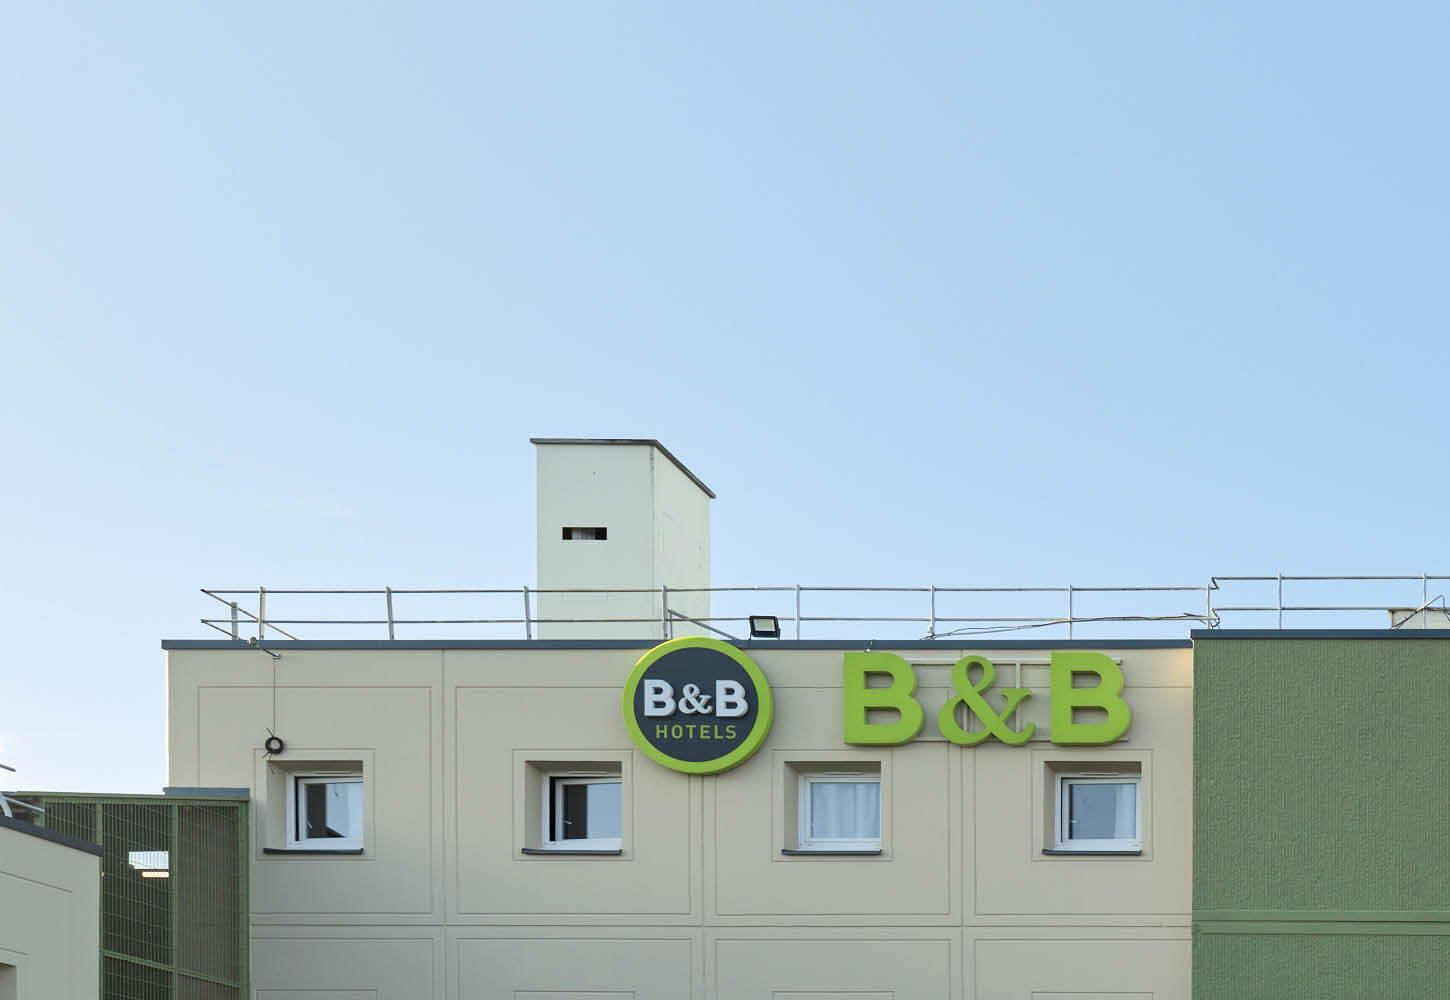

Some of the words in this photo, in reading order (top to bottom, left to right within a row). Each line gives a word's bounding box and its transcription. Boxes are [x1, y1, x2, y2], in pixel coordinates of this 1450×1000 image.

[643, 679, 749, 717] B&B
[843, 652, 1131, 745] B&B
[655, 724, 737, 739] HOTELS
